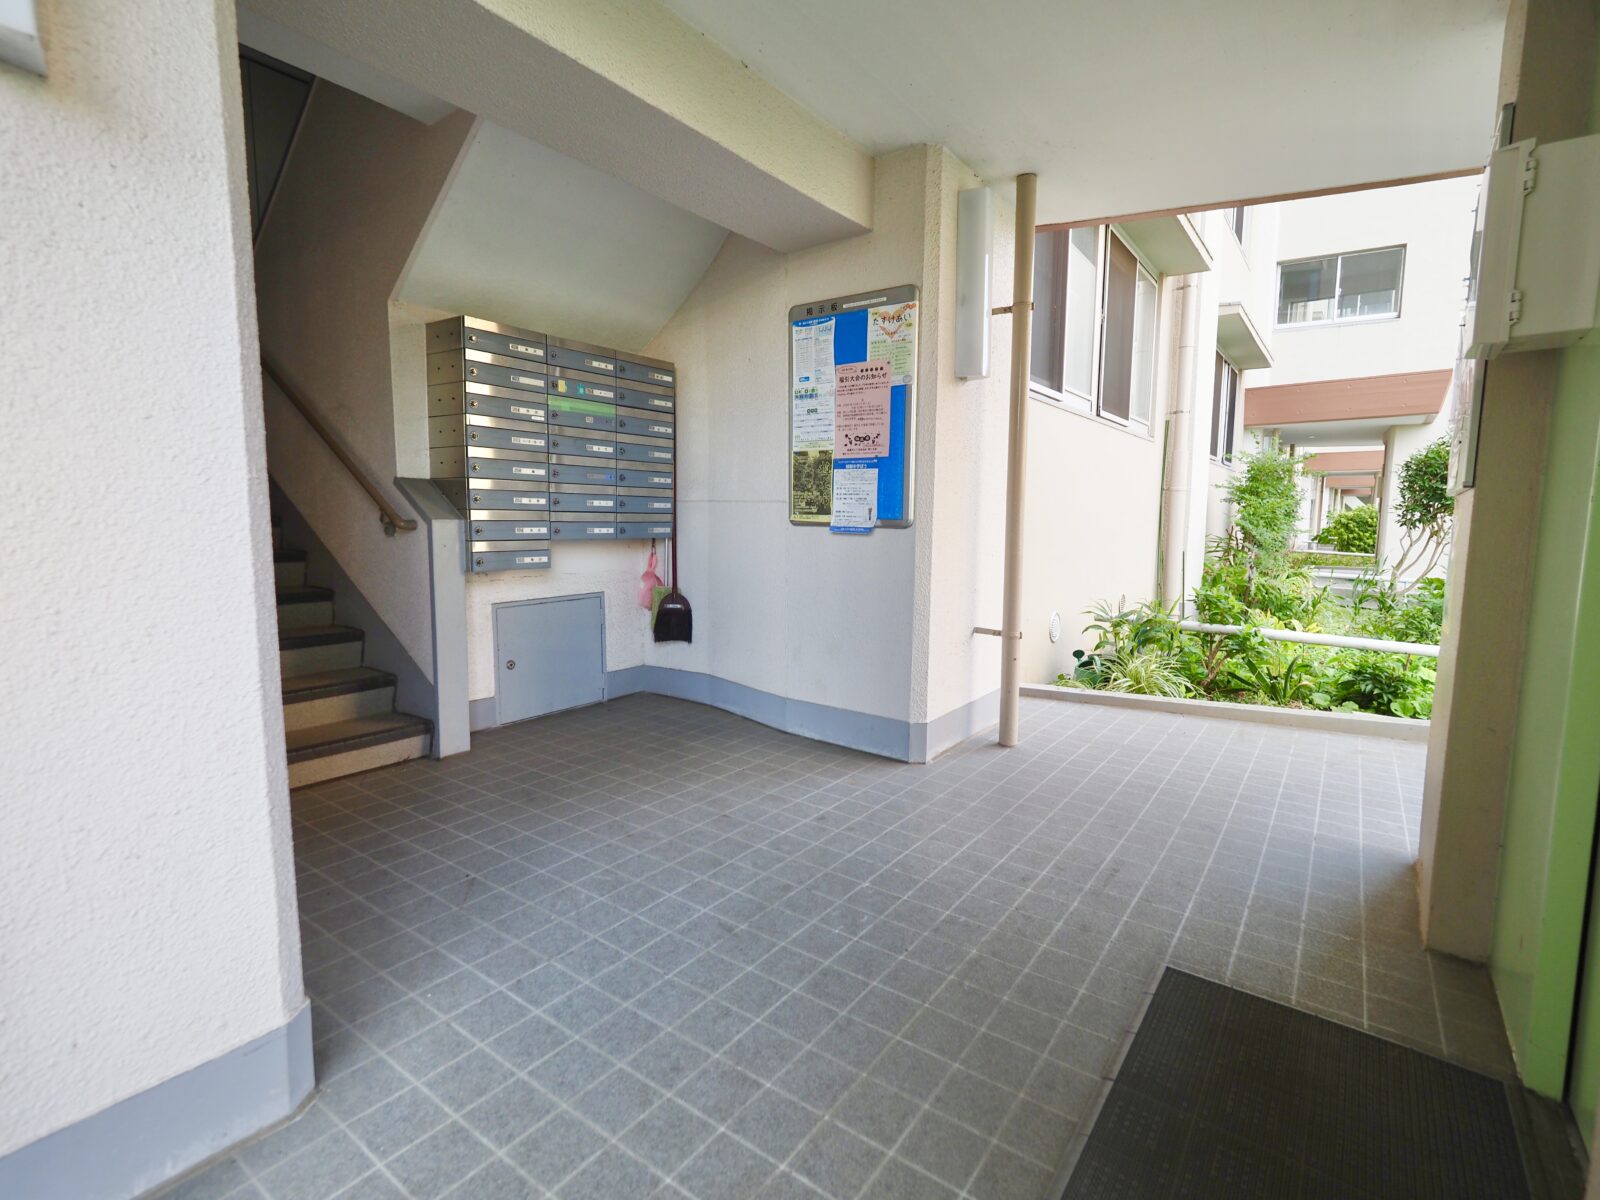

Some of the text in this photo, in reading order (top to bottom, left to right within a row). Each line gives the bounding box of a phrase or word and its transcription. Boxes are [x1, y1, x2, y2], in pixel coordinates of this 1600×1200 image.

[873, 313, 912, 326] たすけあい
